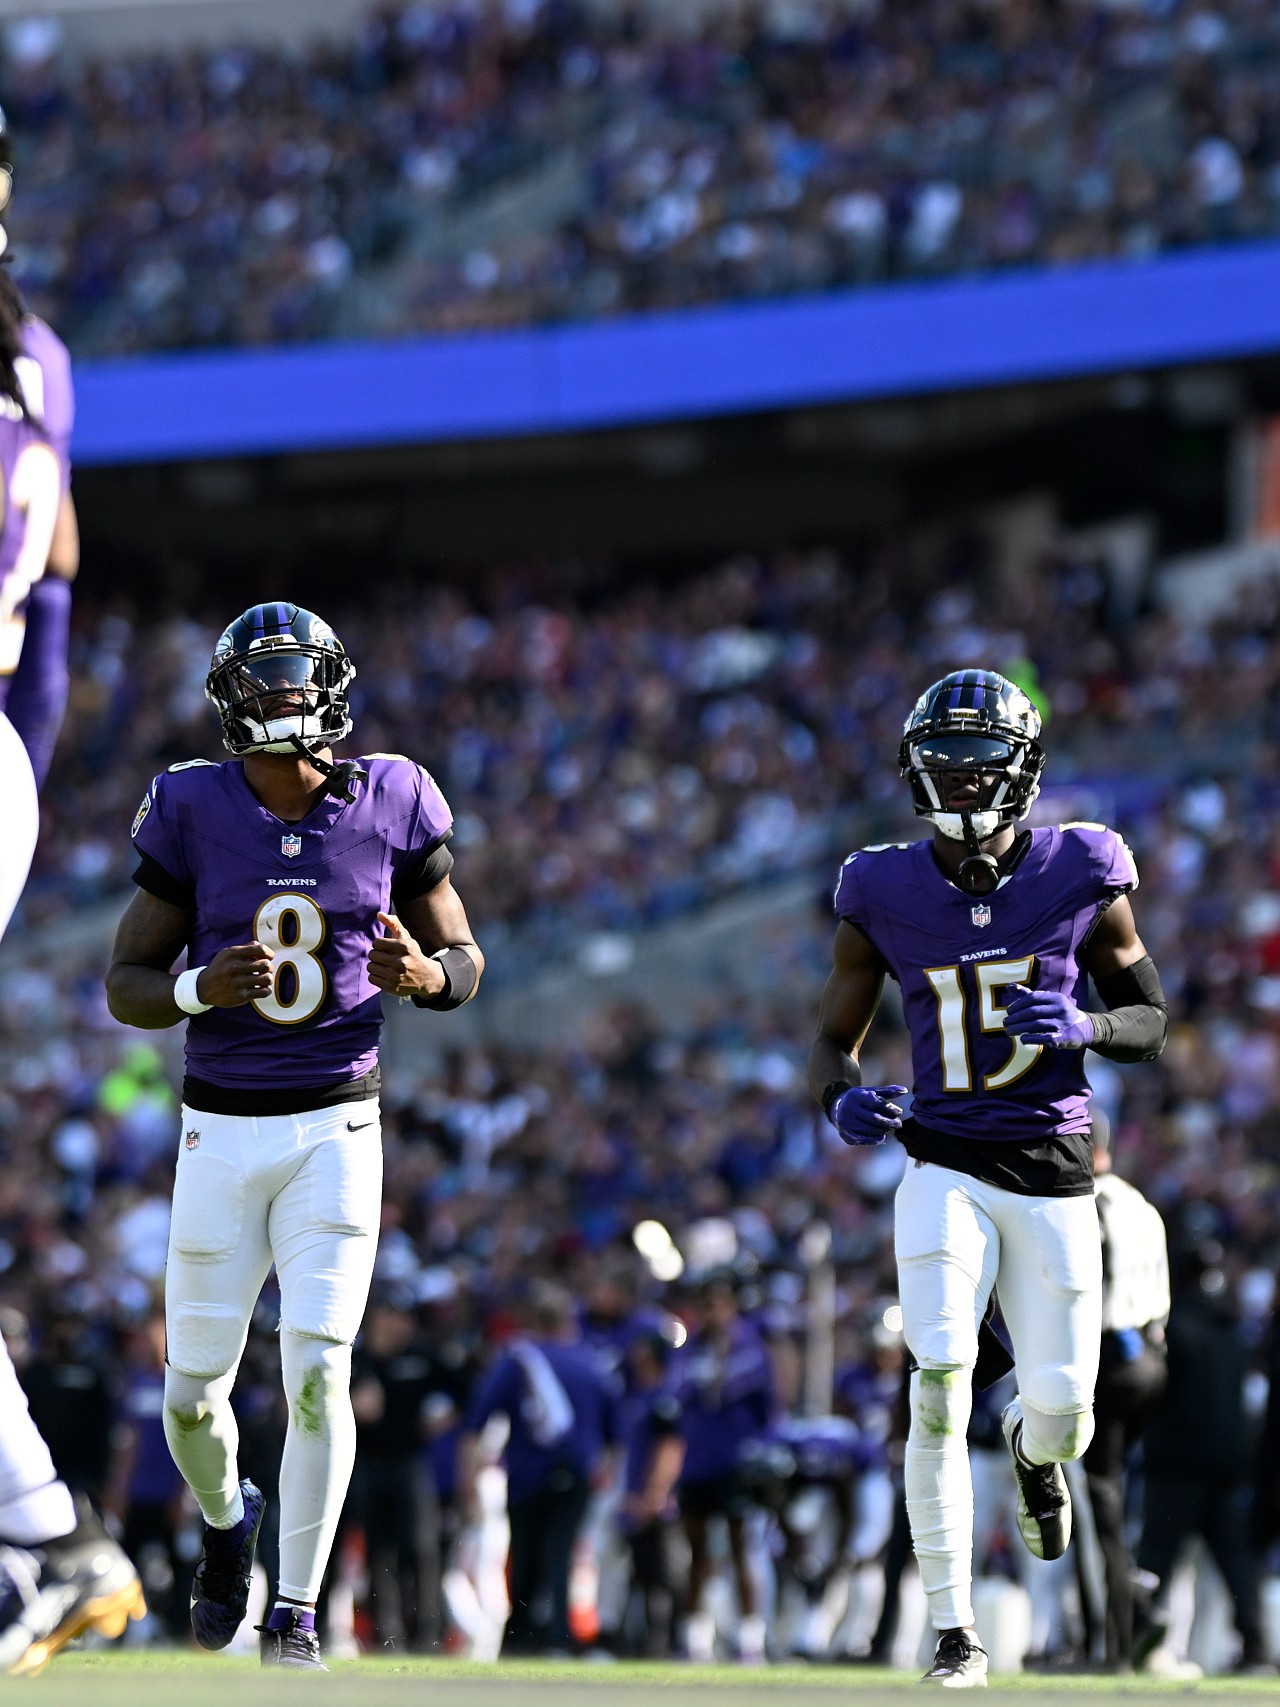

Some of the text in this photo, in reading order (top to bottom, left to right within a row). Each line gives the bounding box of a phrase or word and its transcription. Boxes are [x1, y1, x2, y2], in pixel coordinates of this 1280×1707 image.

[284, 844, 299, 853] NFL
[266, 878, 317, 887] RAVENS
[975, 913, 989, 924] NFL
[252, 892, 328, 1025] 8
[960, 947, 1007, 962] RAVENS
[923, 955, 1045, 1093] 15
